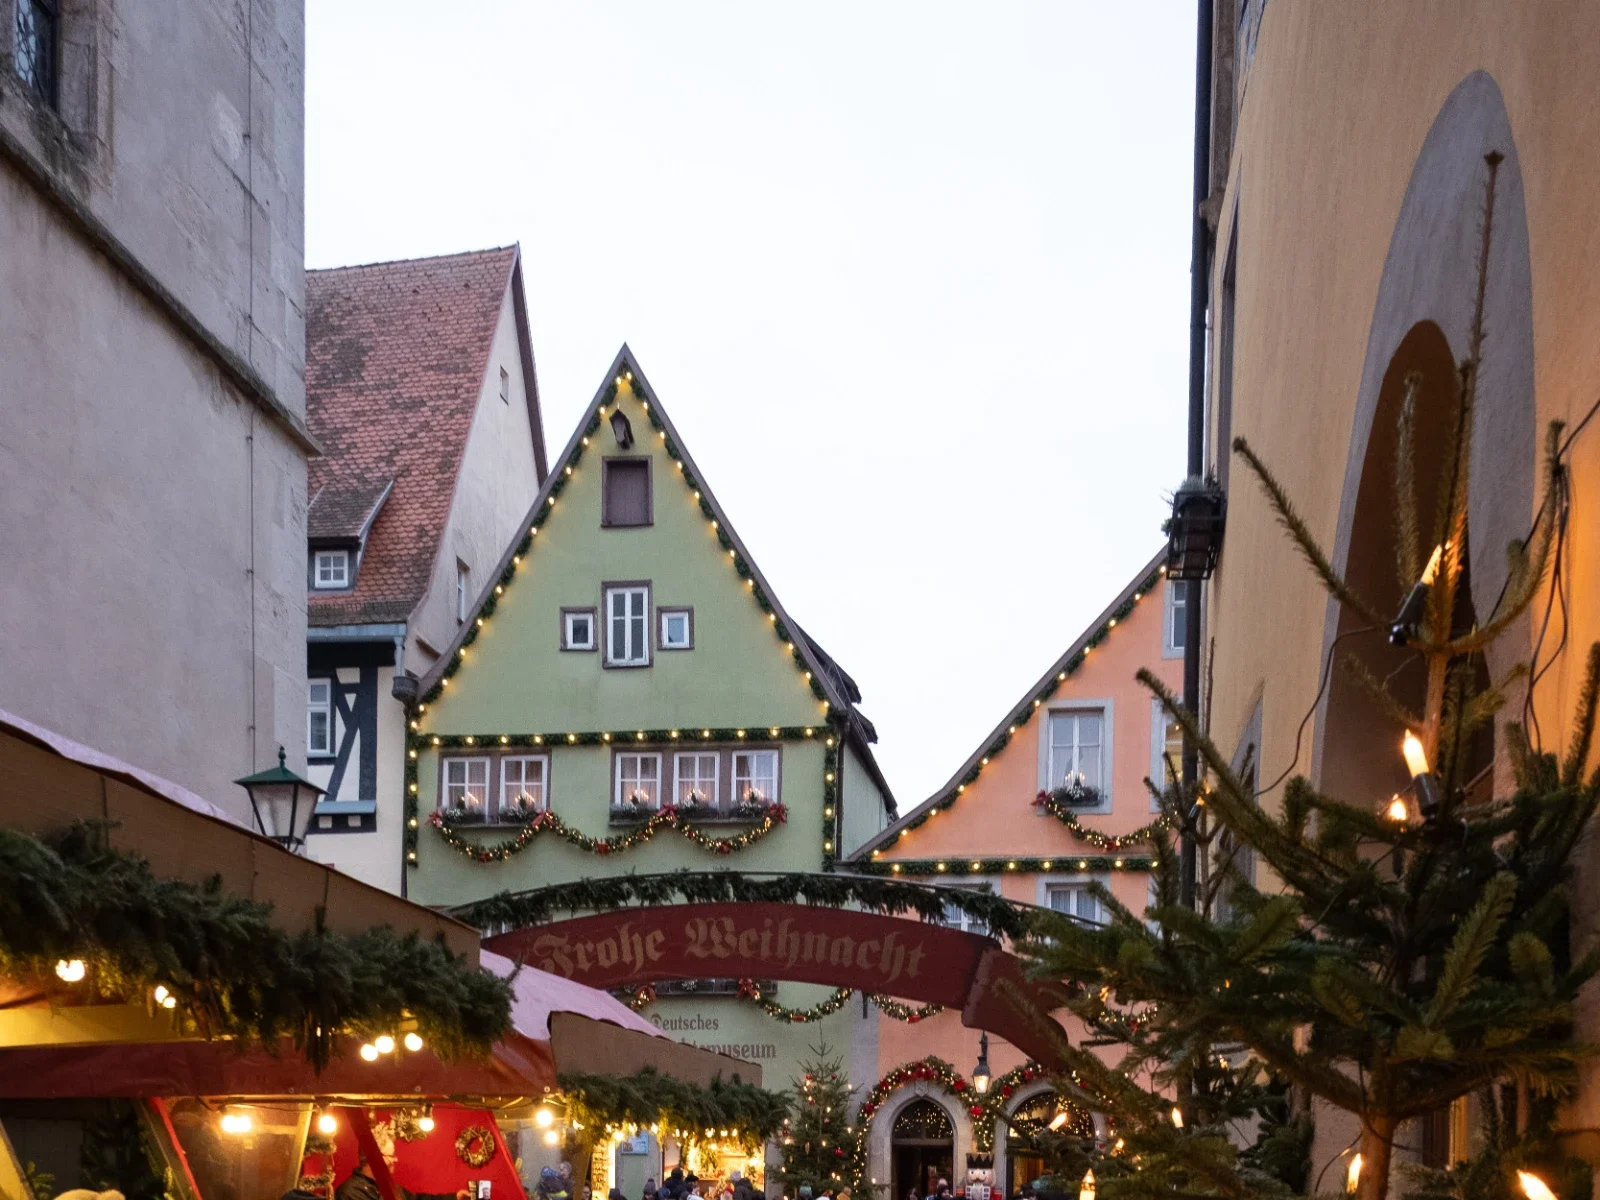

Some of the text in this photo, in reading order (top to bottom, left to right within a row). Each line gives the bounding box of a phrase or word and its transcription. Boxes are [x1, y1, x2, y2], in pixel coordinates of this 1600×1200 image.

[533, 916, 927, 985] Frohe Weihnacht
[681, 1038, 777, 1059] museum
